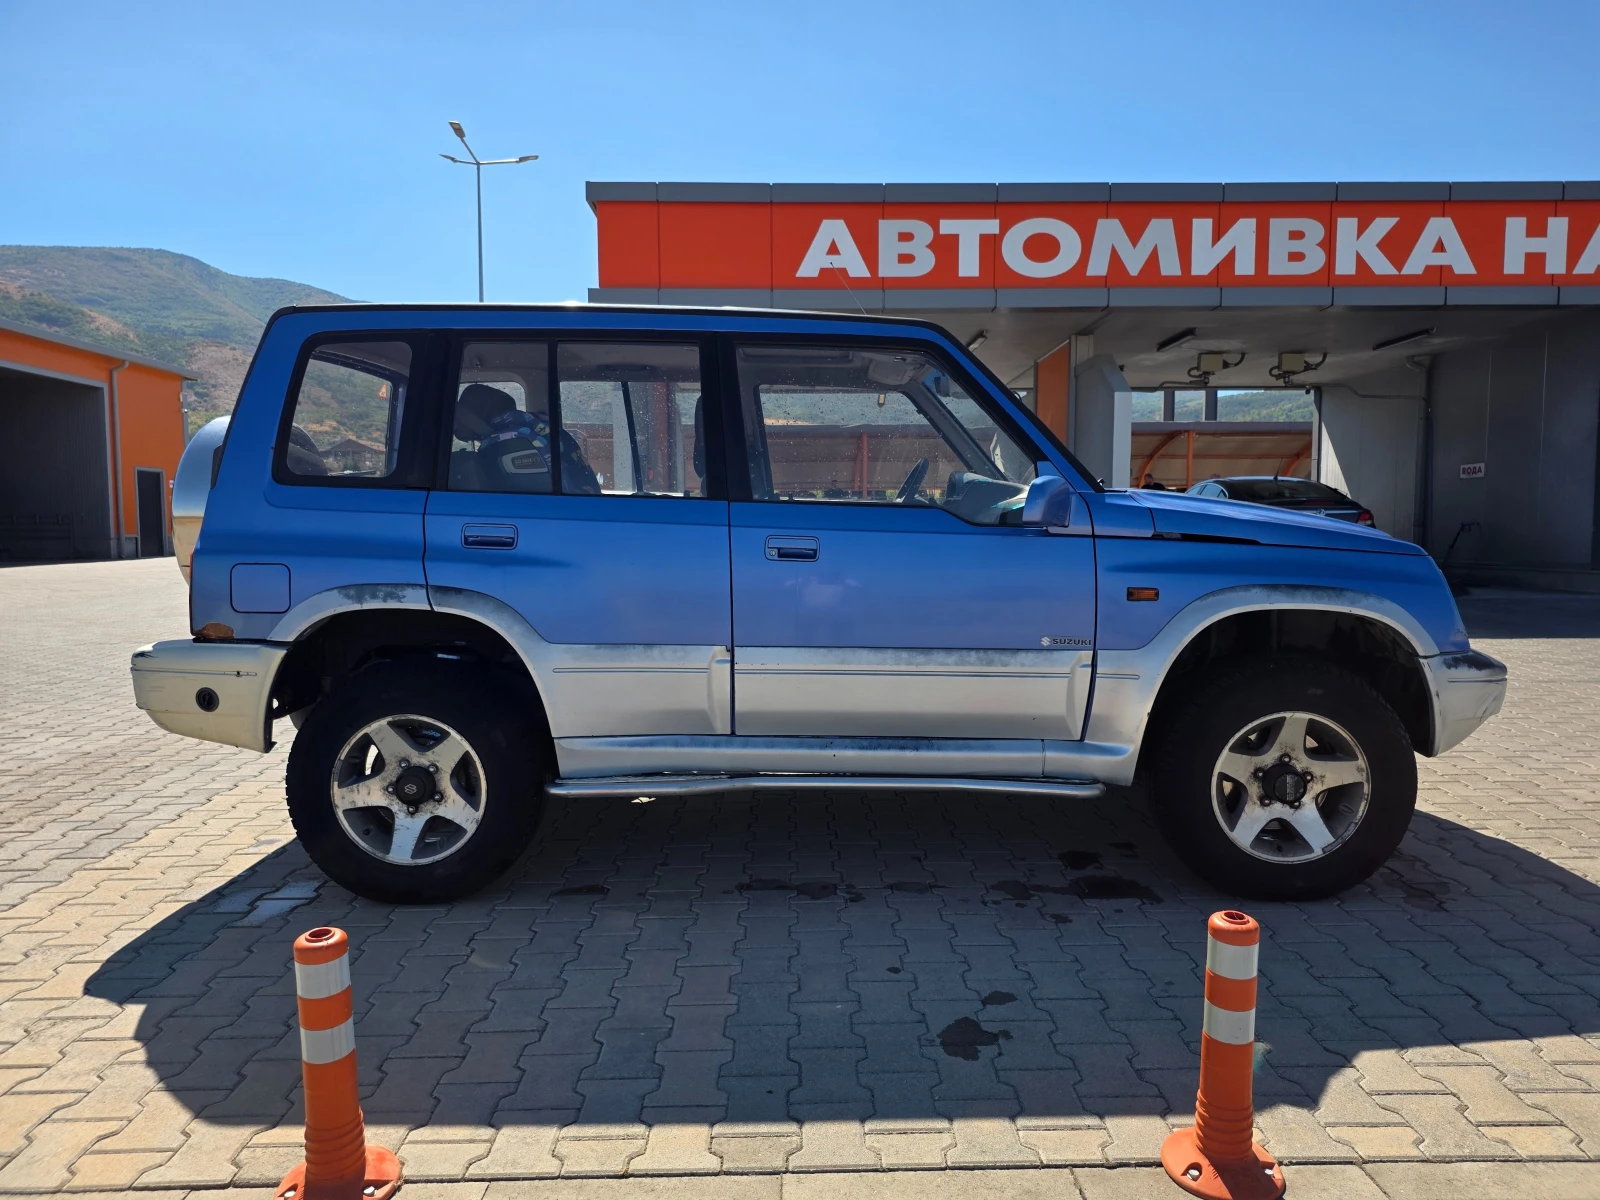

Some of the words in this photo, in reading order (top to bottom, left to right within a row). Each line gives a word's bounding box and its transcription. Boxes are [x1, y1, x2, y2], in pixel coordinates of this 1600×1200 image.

[796, 216, 1477, 278] АВТОМИВКА
[1461, 465, 1482, 475] ВОДА
[1052, 638, 1092, 646] SUZUKI
